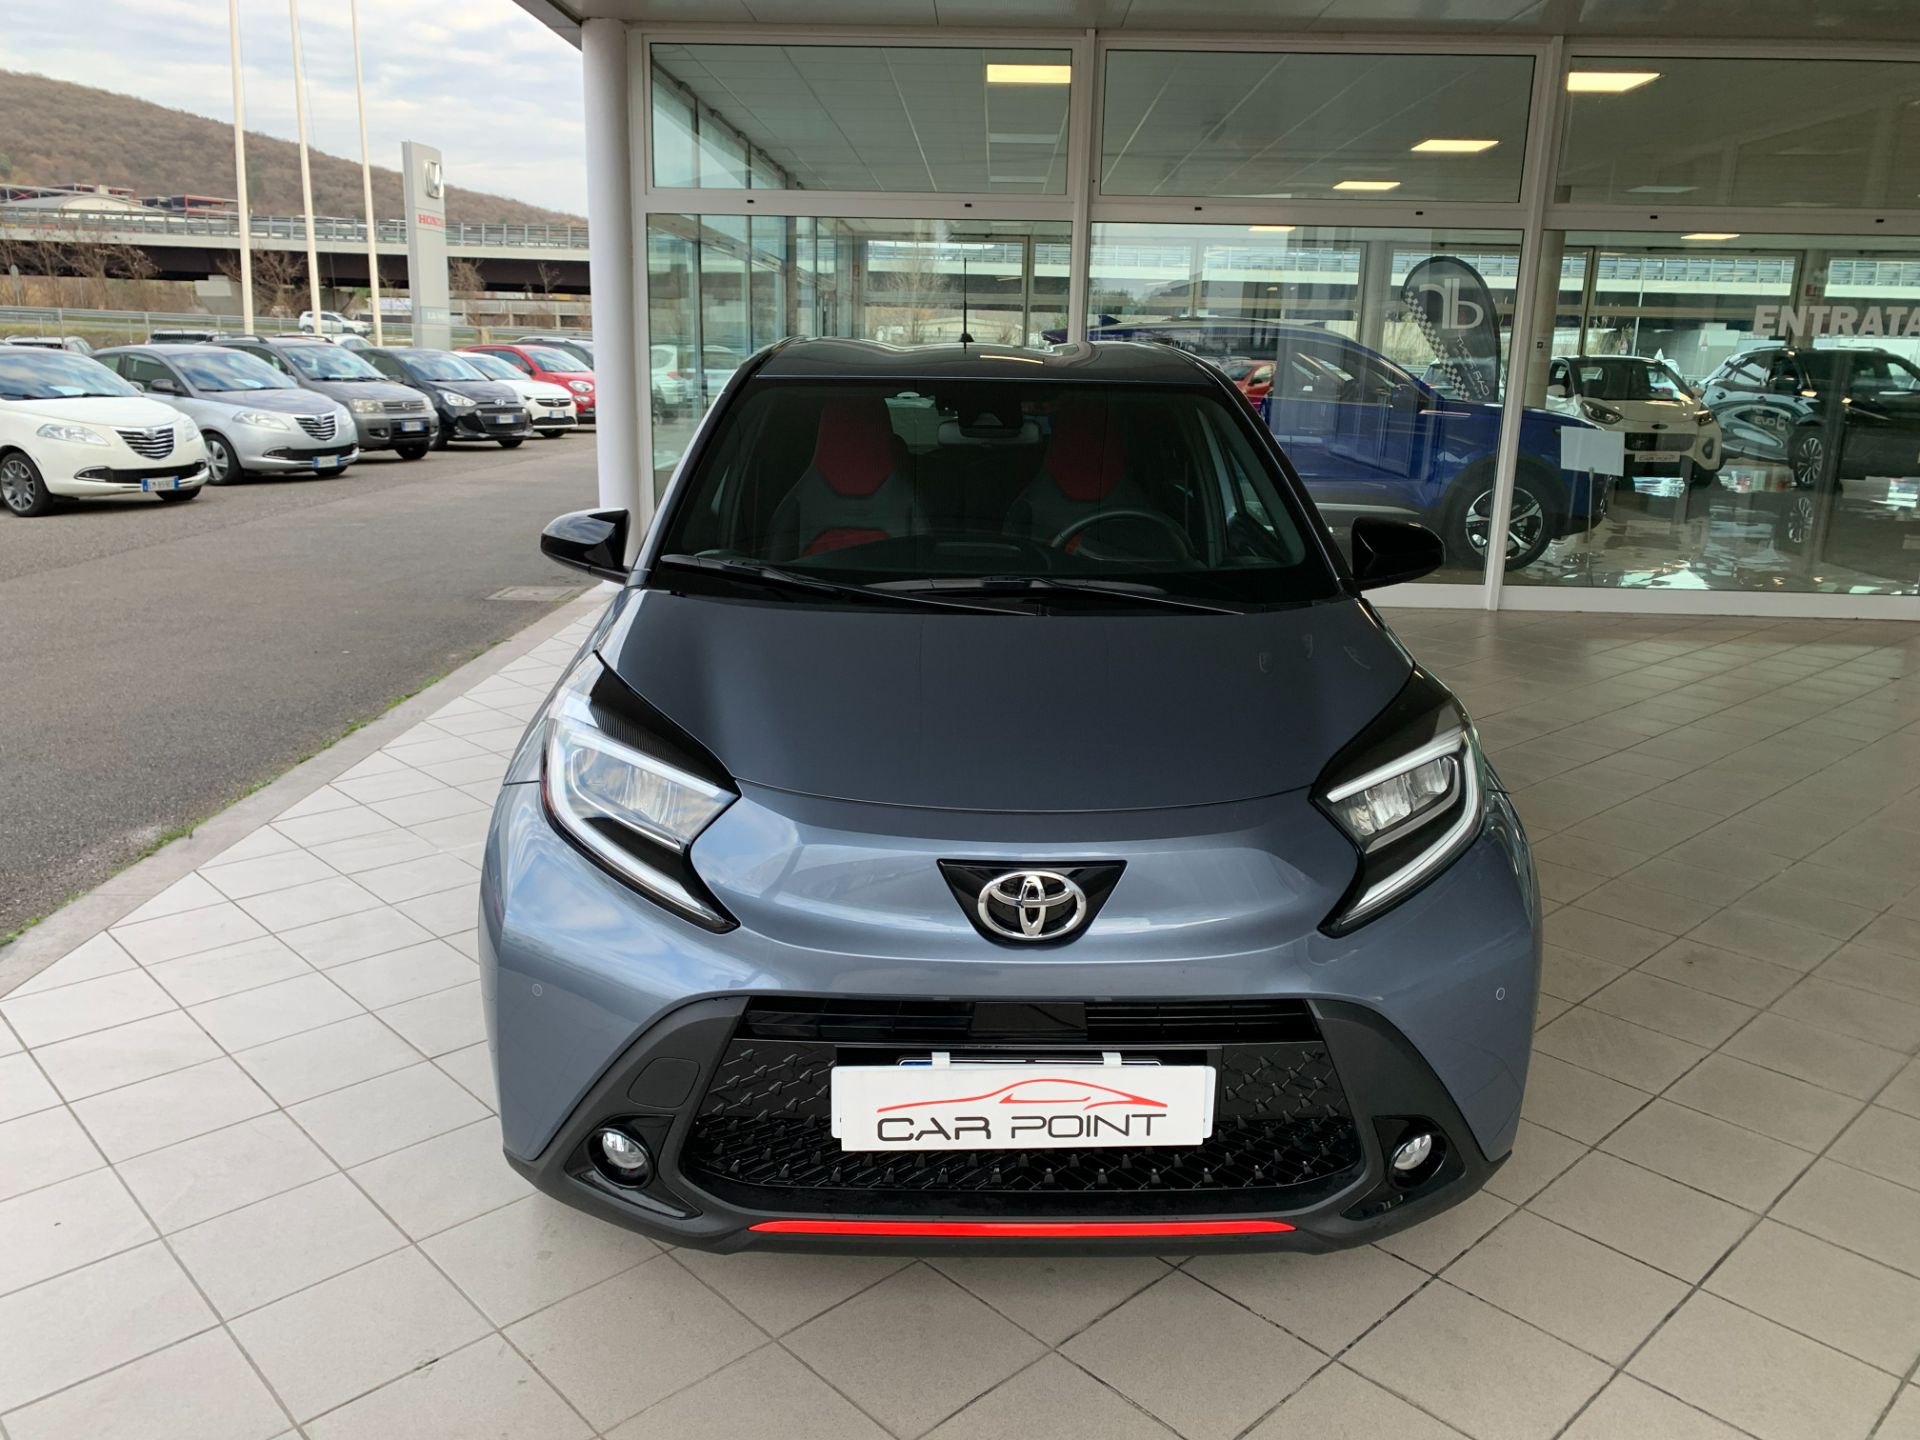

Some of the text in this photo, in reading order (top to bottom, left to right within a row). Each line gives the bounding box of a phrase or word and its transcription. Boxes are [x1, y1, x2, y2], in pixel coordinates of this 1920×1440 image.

[1753, 304, 1920, 338] ENTRATA
[876, 1113, 1168, 1142] CAR POINT
